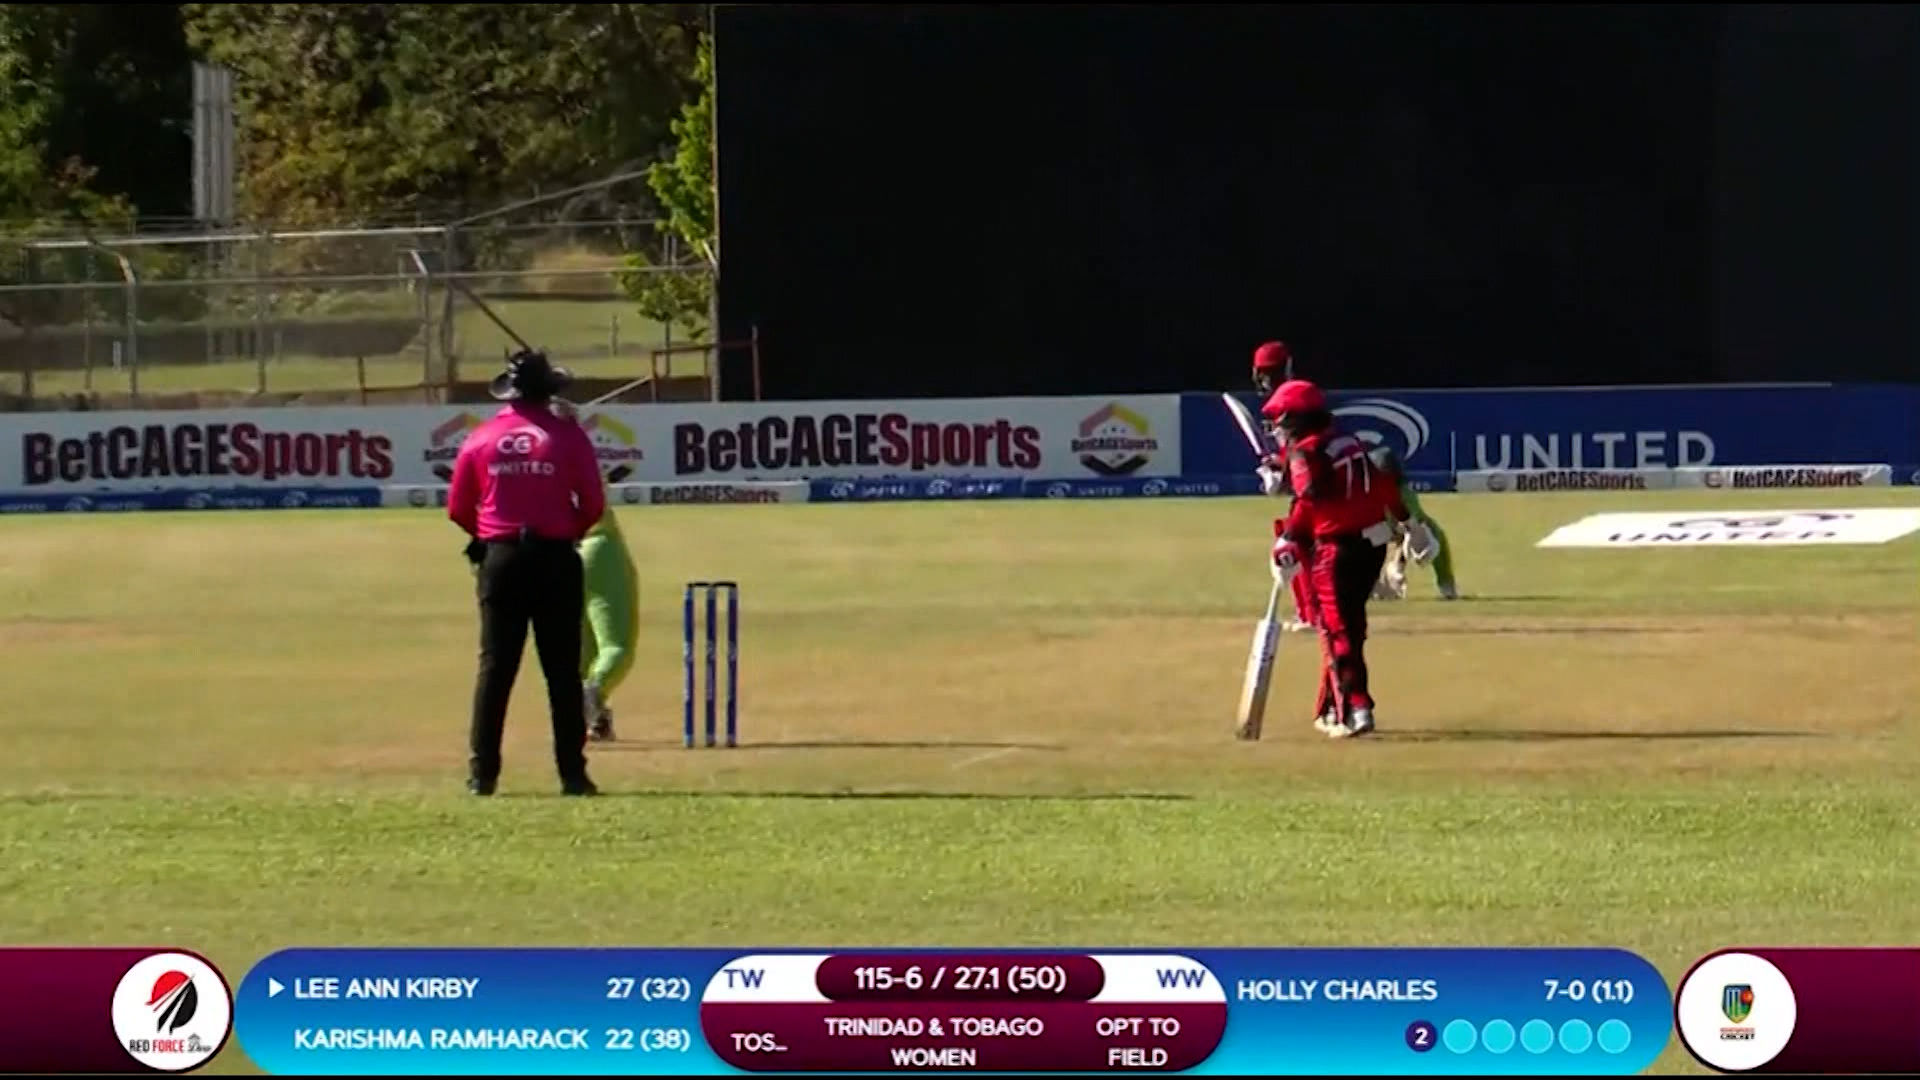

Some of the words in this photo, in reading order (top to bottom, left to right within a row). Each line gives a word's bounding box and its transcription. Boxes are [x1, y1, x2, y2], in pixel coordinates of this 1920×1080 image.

[21, 421, 395, 486] BetCAGESports
[496, 434, 533, 455] CG
[674, 413, 1042, 476] BetCAGESports
[1474, 431, 1717, 470] UNITED
